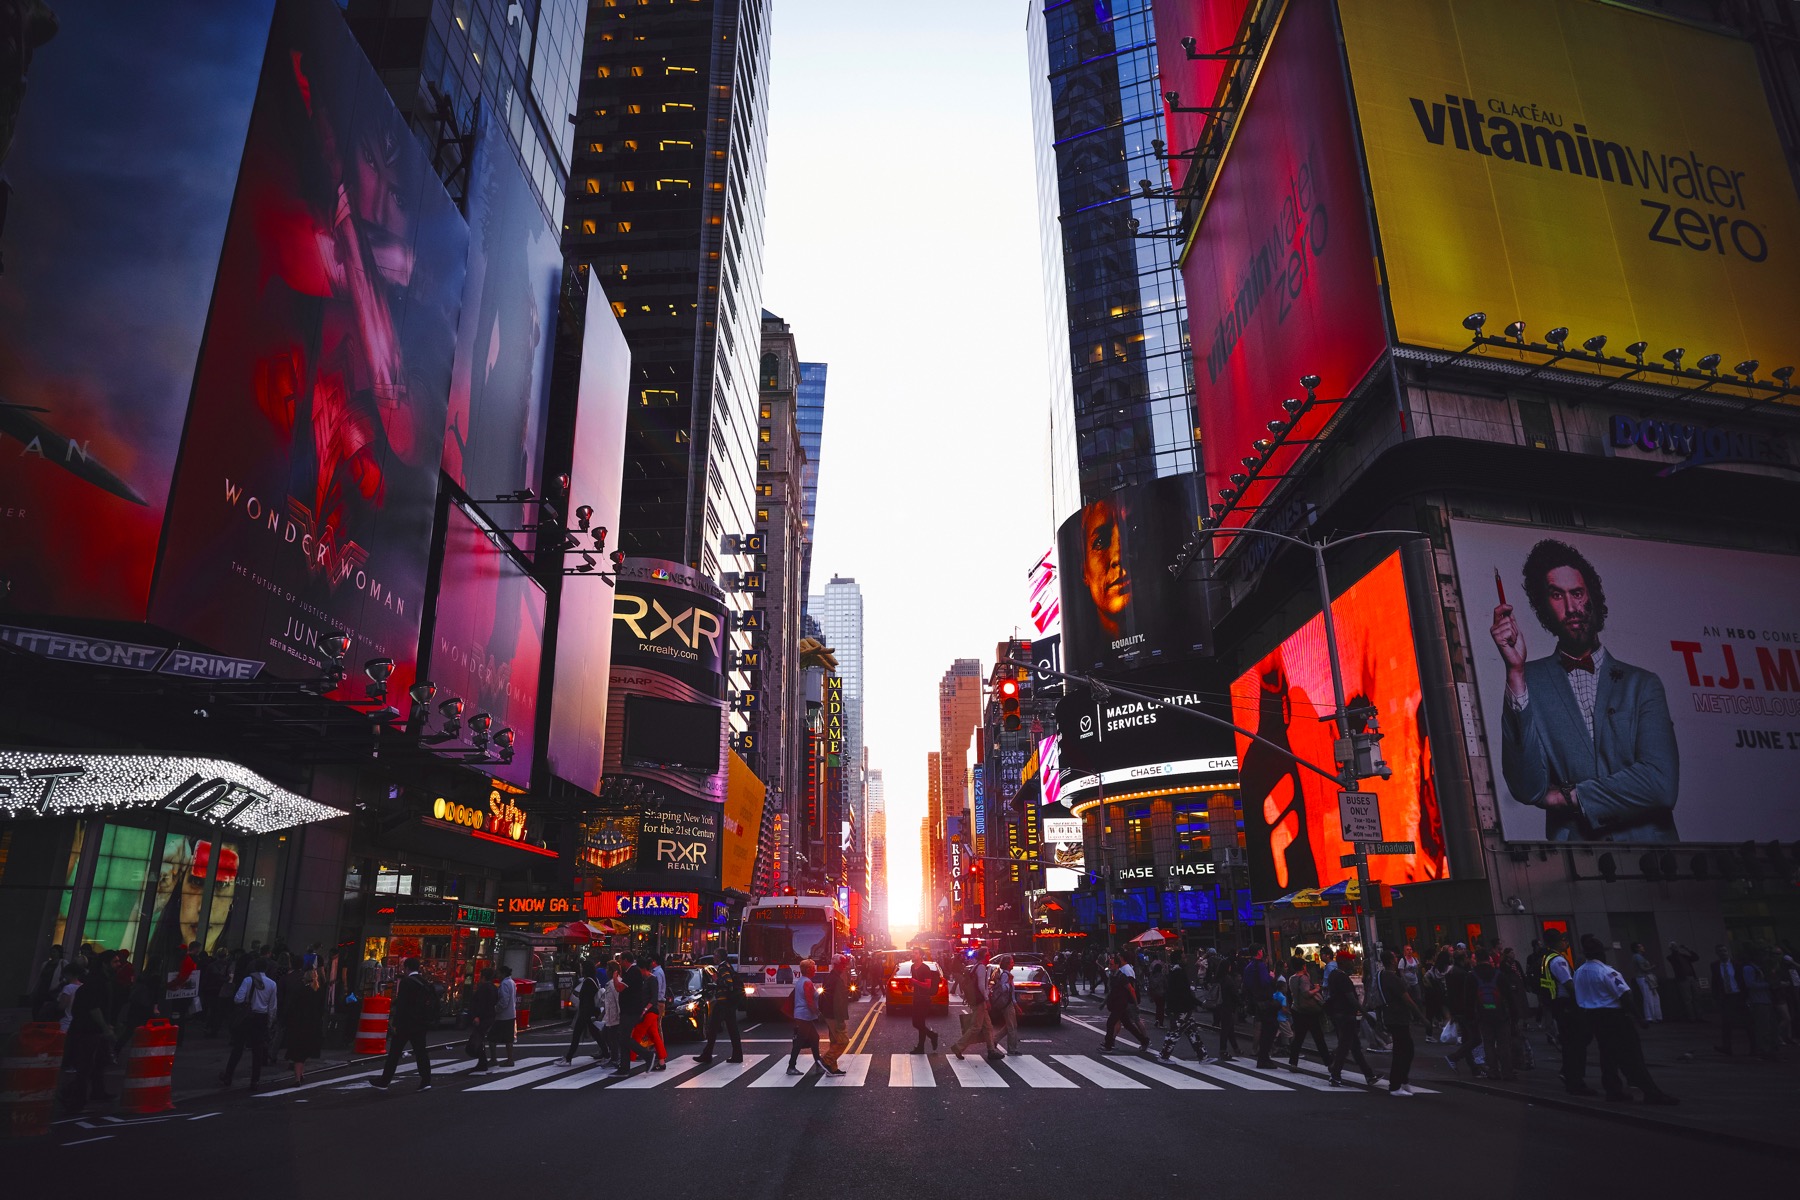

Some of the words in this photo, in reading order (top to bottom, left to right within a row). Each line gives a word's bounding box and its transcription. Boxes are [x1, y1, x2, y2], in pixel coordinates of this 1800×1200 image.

[1409, 93, 1745, 210] vitaminwater
[1640, 198, 1769, 262] zero
[1275, 203, 1328, 325] zero
[1609, 415, 1697, 456] DOW
[225, 478, 329, 566] WONDER
[341, 558, 405, 616] WOMAN
[231, 561, 247, 577] THE
[252, 573, 282, 596] FUTURE
[286, 592, 296, 603] OF
[299, 601, 328, 622] JUSTICE
[330, 617, 355, 636] BEGINS
[358, 630, 373, 645] WITH
[375, 642, 386, 654] HER
[284, 616, 325, 649] JUN
[613, 594, 719, 658] RXR
[1703, 626, 1720, 638] AN
[1726, 628, 1756, 640] HBO
[1111, 633, 1146, 650] EQUALITY.
[638, 643, 698, 661] rxrrealty.com
[174, 654, 253, 680] PRIME
[441, 637, 492, 684] WONDER
[498, 679, 533, 708] WOMAN
[1670, 640, 1755, 690] T.J.
[610, 676, 652, 685] SHARP
[828, 677, 841, 753] MADAME
[1106, 702, 1144, 719] MAZDA
[1107, 713, 1157, 731] SERVICES
[1736, 729, 1784, 750] JUNE
[1130, 766, 1162, 778] CHASE
[1208, 759, 1238, 769] CHAS
[1079, 776, 1098, 788] CHASE
[159, 772, 269, 824] LOFT
[1346, 796, 1371, 805] BUSES
[683, 812, 700, 823] New
[701, 814, 714, 825] York
[1350, 806, 1368, 815] ONLY
[643, 822, 658, 833] for
[660, 823, 674, 834] the
[675, 825, 691, 836] 21st
[691, 826, 716, 842] Century
[1027, 803, 1037, 845] VICTORY
[1049, 826, 1081, 834] WORK
[657, 839, 707, 865] RXR
[1377, 843, 1414, 853] Broadway
[667, 862, 700, 871] REALTY
[952, 843, 961, 901] REGAL
[1119, 867, 1154, 879] CHASE
[1170, 863, 1216, 876] CHASE
[508, 898, 546, 912] KNOW
[549, 897, 582, 912] GAE
[617, 896, 690, 913] CHAMPS
[468, 909, 491, 921] WATER
[429, 926, 450, 934] FOOD
[1326, 918, 1349, 931] SODA
